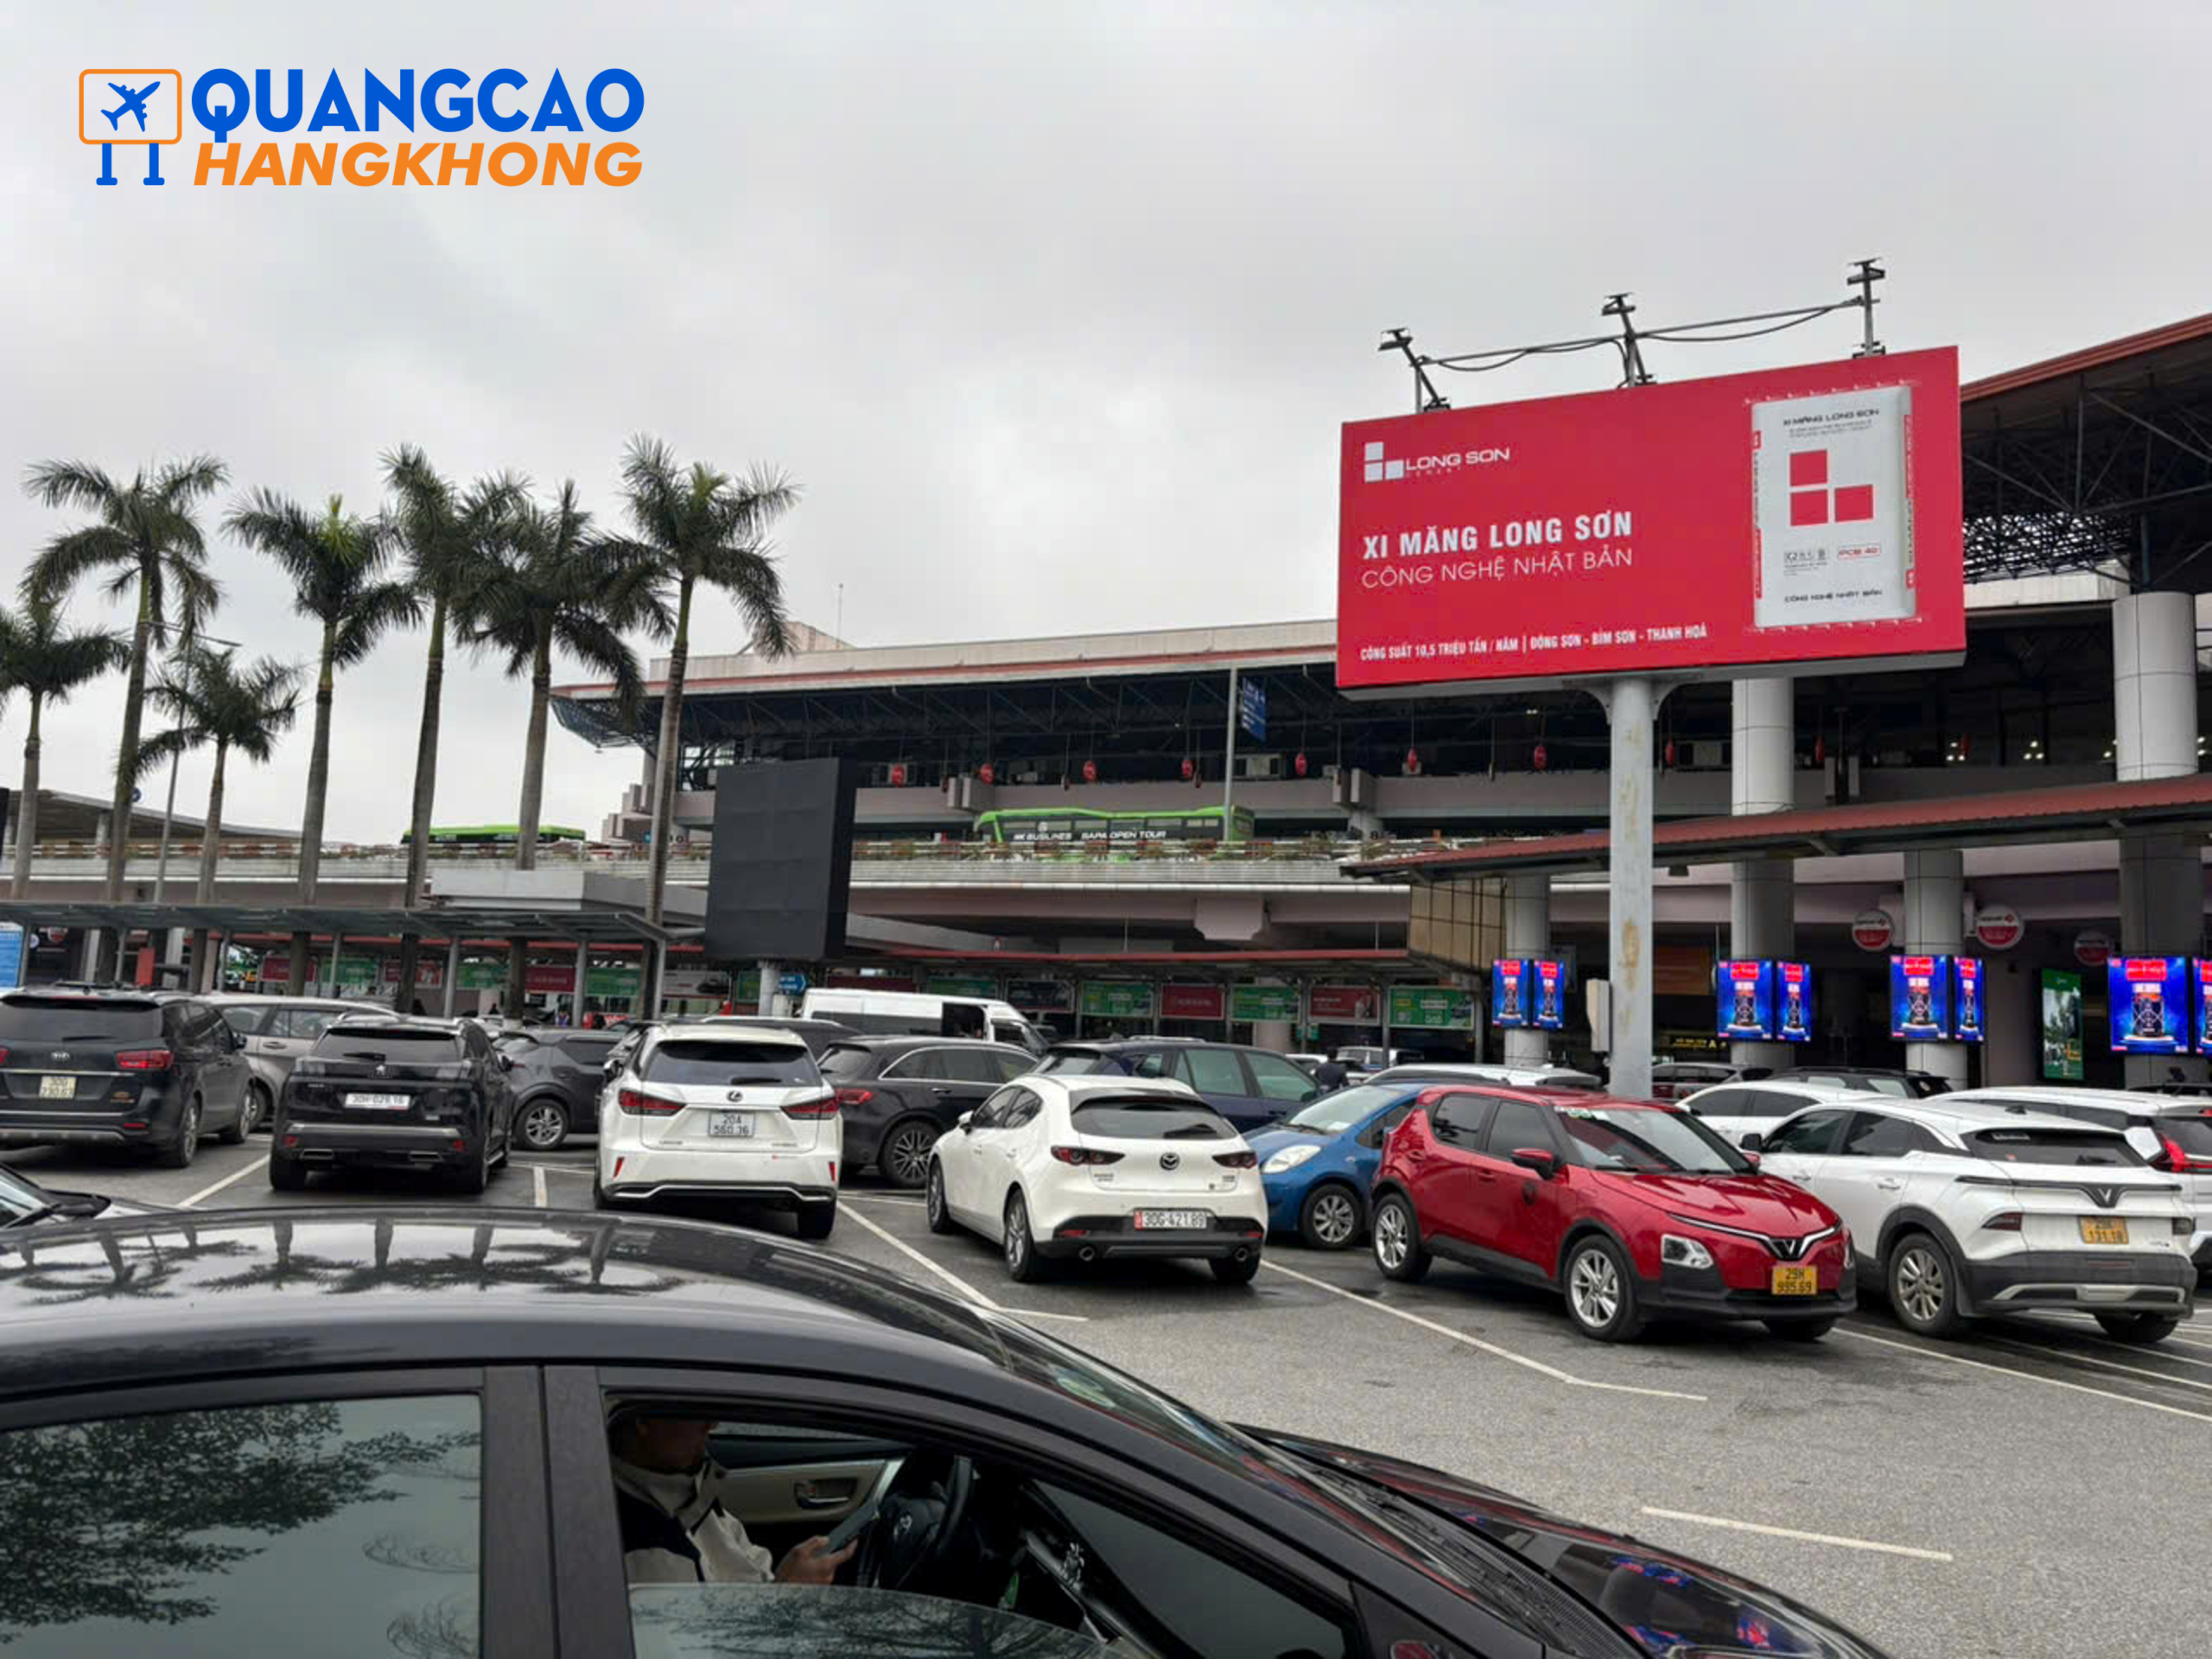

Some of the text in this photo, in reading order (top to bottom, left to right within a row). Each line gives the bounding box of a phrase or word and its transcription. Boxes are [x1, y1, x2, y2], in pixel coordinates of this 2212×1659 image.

[1406, 453, 1461, 471] LONG
[1363, 509, 1632, 560] XI MĂNG LONG SƠN
[1362, 544, 1632, 588] CÔNG NGHỆ NHẬT BẢN
[1139, 830, 1166, 839] TOUR
